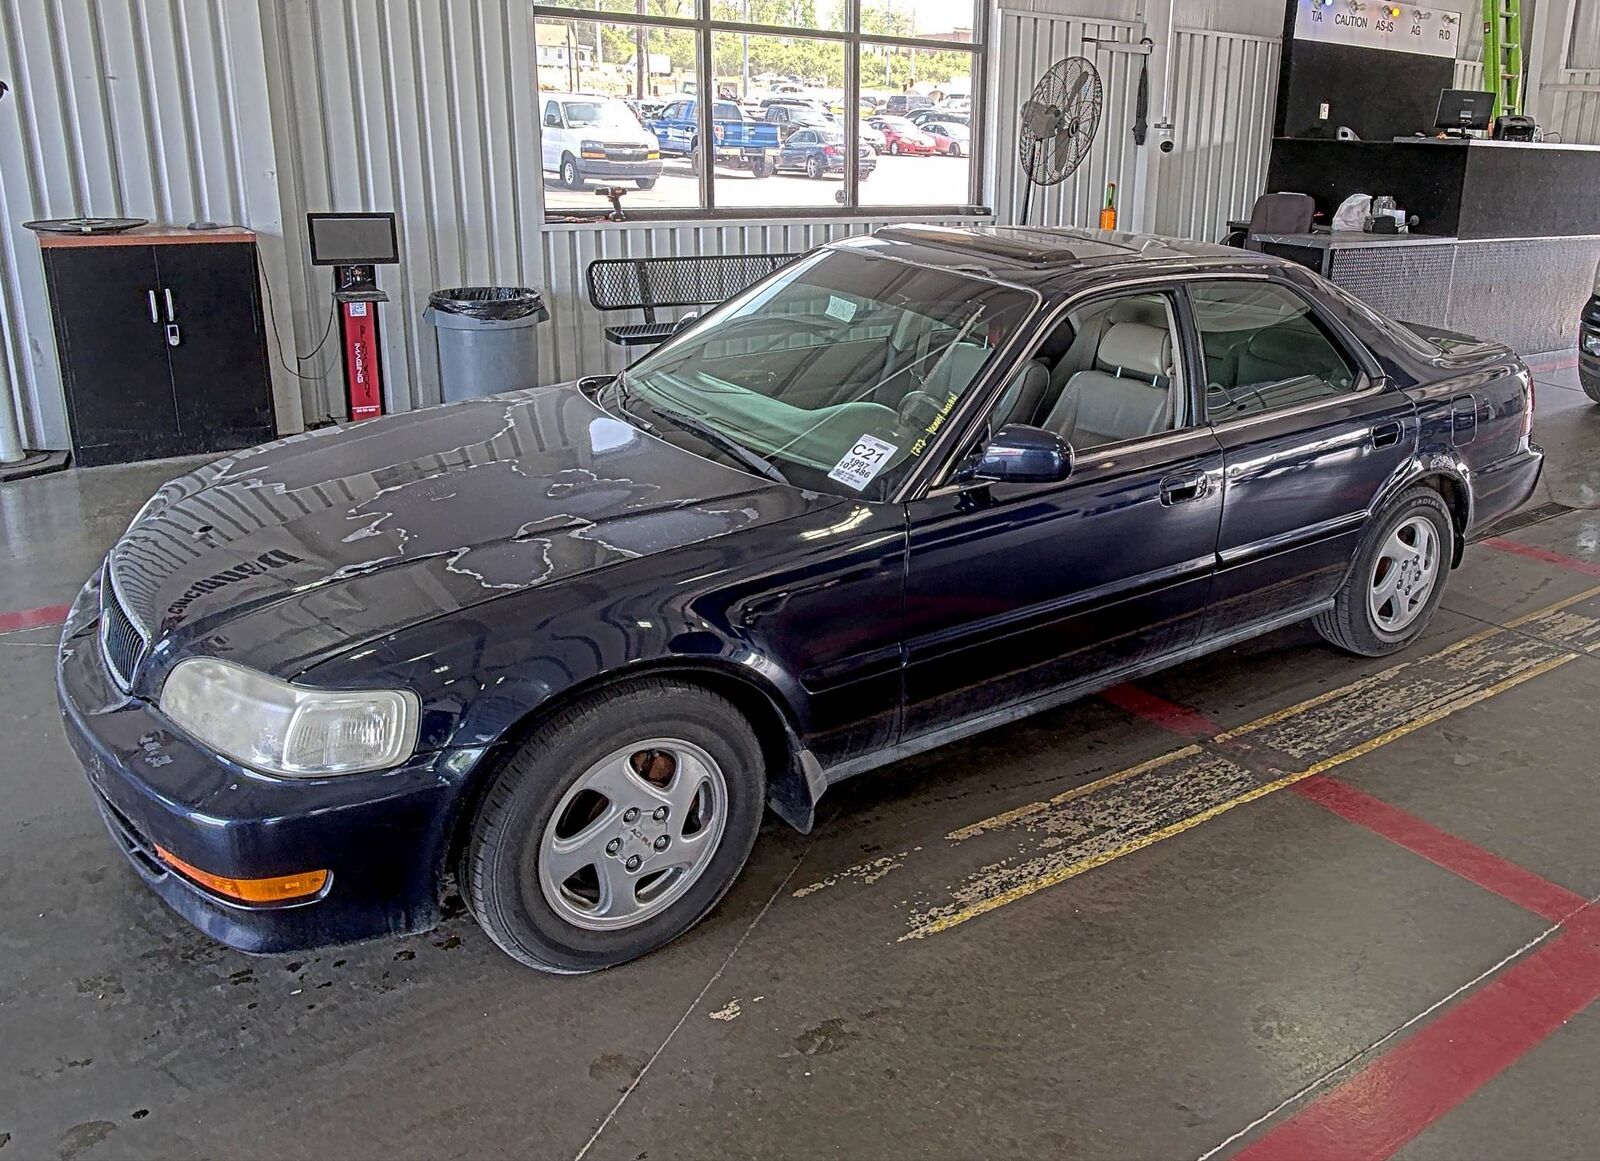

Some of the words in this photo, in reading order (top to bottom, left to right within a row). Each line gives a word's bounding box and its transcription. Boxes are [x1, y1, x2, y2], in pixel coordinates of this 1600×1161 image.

[1311, 11, 1323, 23] T/A
[1335, 14, 1368, 28] CAUTION
[1375, 20, 1394, 33] AS-IS
[1411, 26, 1421, 36] AG
[852, 443, 884, 464] C21
[839, 460, 871, 479] 107,486
[849, 458, 870, 469] 1997
